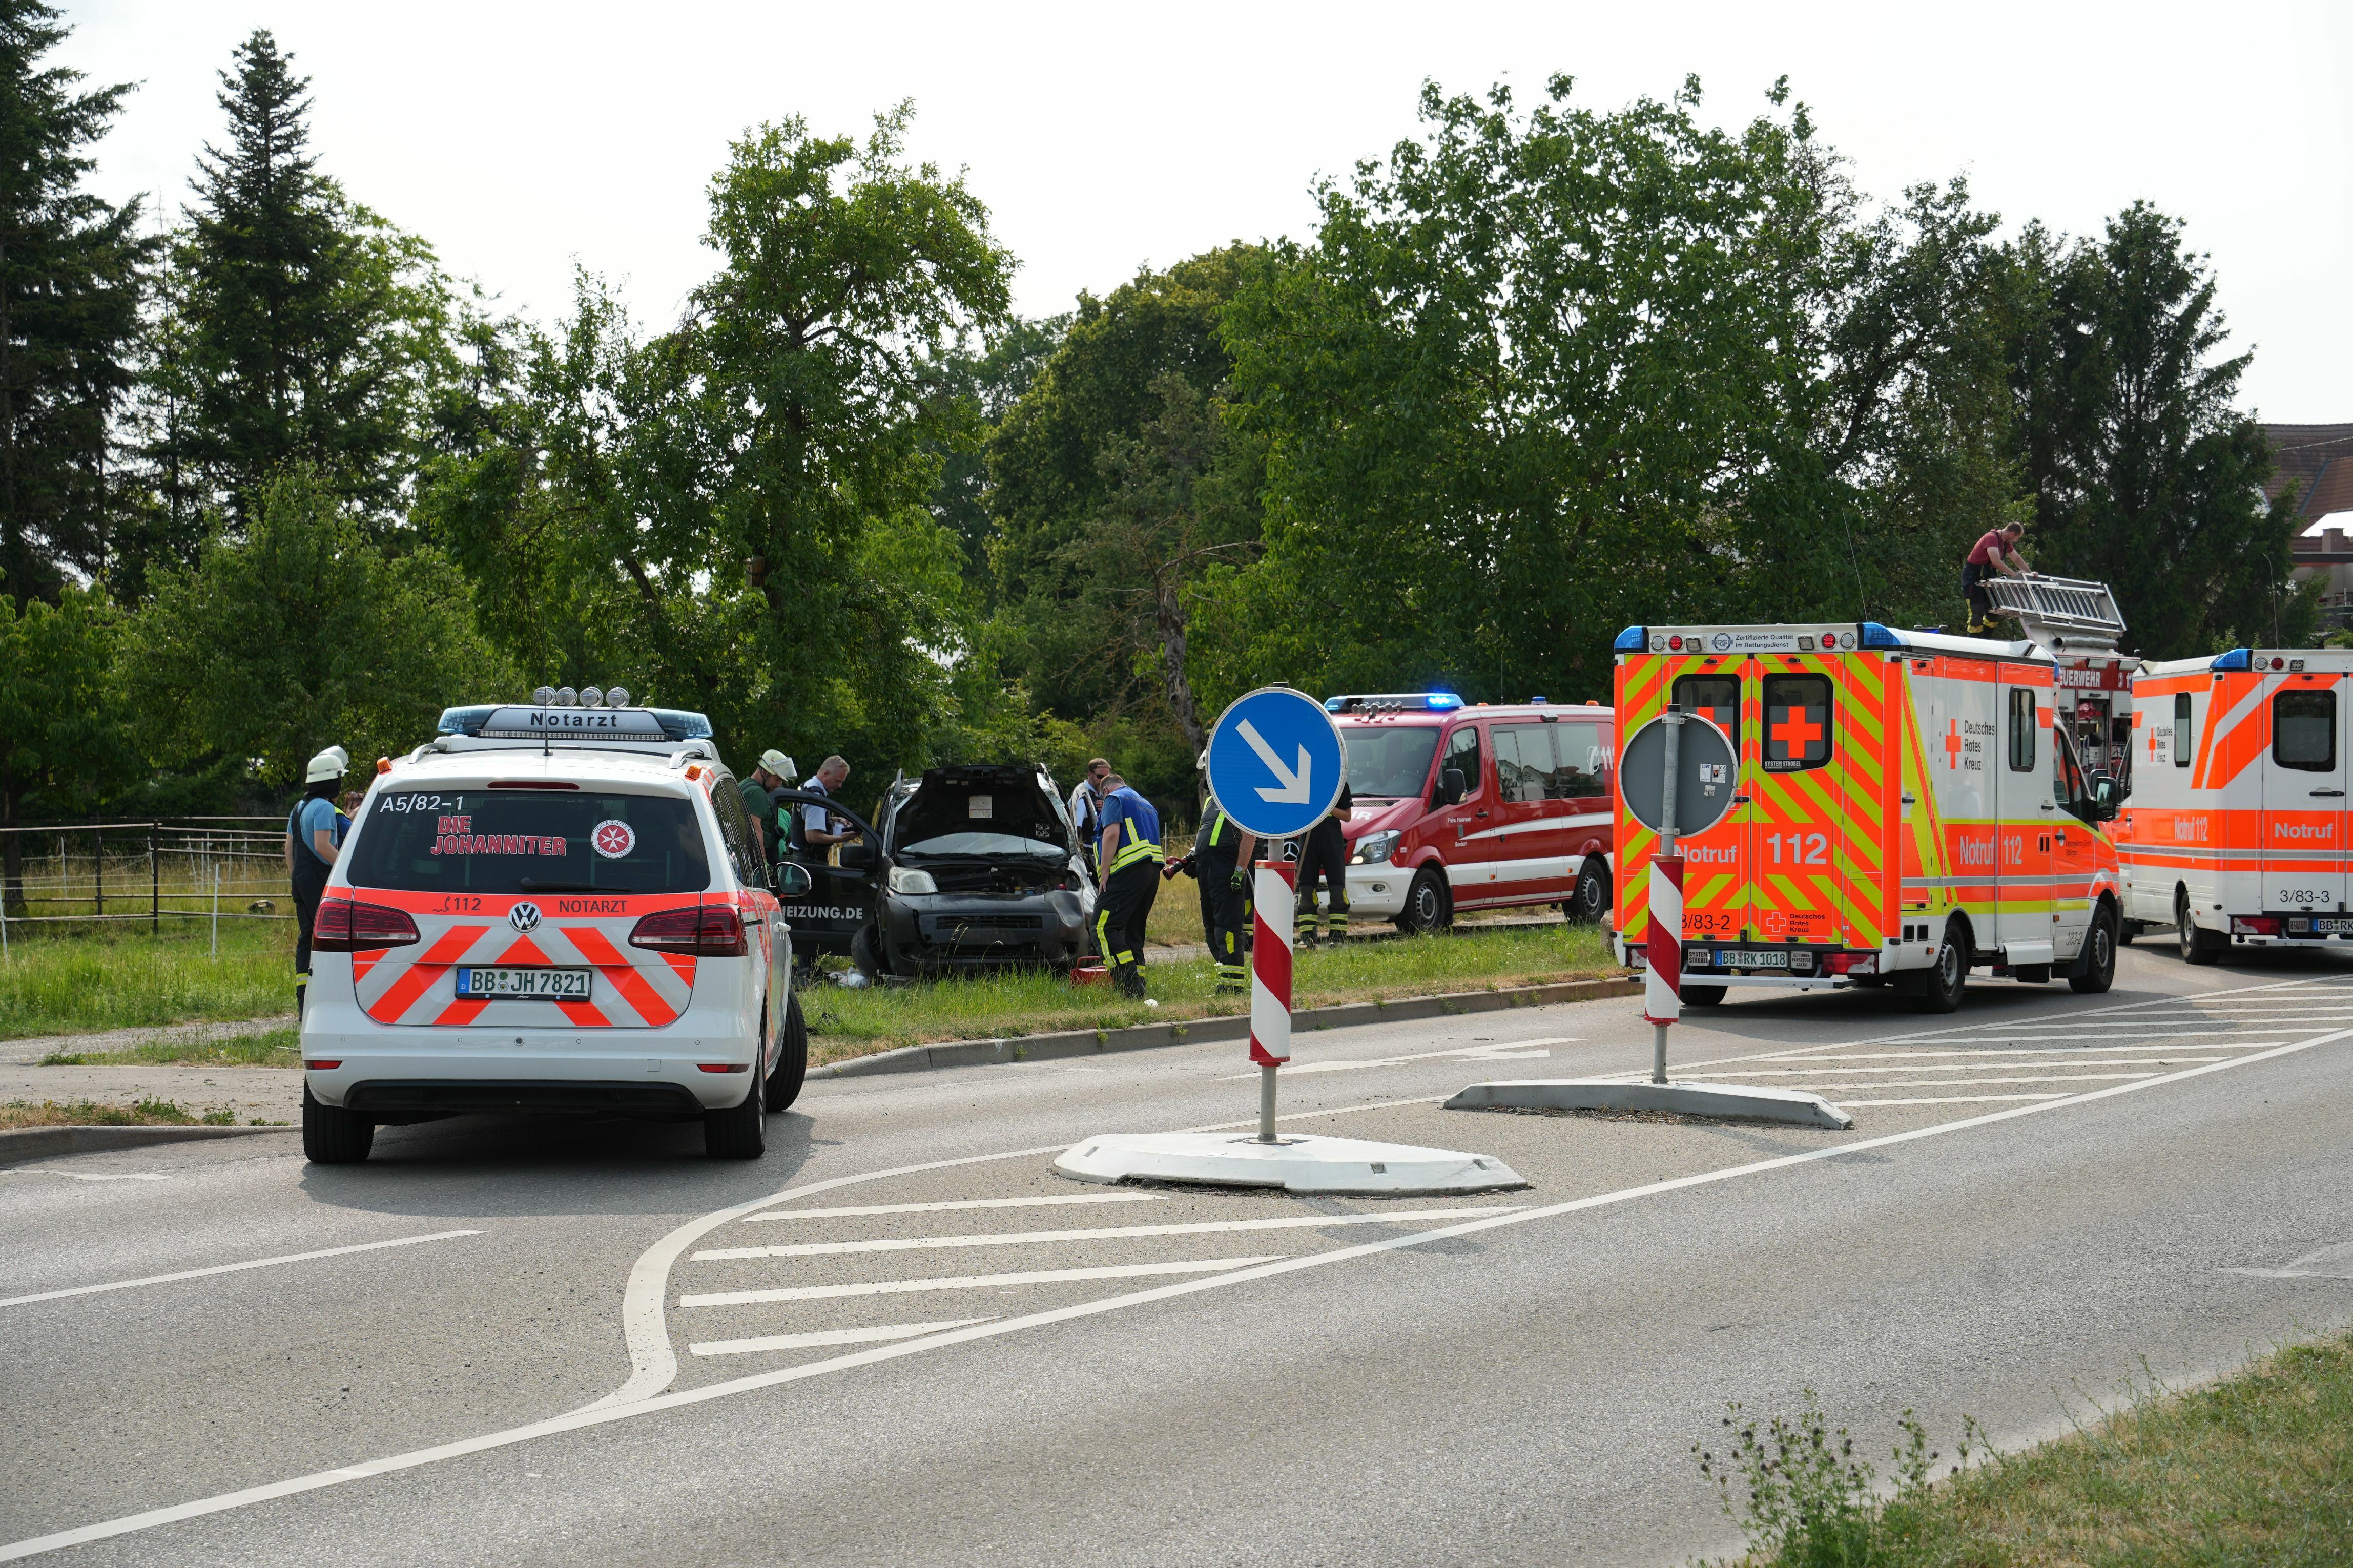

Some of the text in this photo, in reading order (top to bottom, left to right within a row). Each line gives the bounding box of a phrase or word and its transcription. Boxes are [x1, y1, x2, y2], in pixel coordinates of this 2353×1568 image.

[531, 713, 617, 727] Notarzt
[1965, 720, 1995, 736] Deutsches
[1964, 738, 1981, 752] Rotes
[1964, 757, 1981, 770] Kreuz
[379, 794, 463, 813] A5/82-1
[437, 815, 471, 834] DIE
[2174, 817, 2208, 841] Notruf 112
[2275, 823, 2333, 838] Notruf
[430, 835, 566, 856] JOHANNITER
[1674, 833, 1827, 864] Notruf 112
[1959, 835, 2022, 865] Notruf 112
[453, 897, 481, 910] 112
[2280, 890, 2329, 903] 3/83-3
[559, 900, 628, 913] NOTARZT
[2319, 920, 2333, 930] BB
[2341, 921, 2353, 930] RK
[1722, 952, 1736, 964] BB
[1744, 953, 1757, 965] RK
[1759, 953, 1785, 965] 1018
[471, 972, 496, 991] BB
[511, 972, 535, 992] JH
[540, 973, 586, 994] 7821
